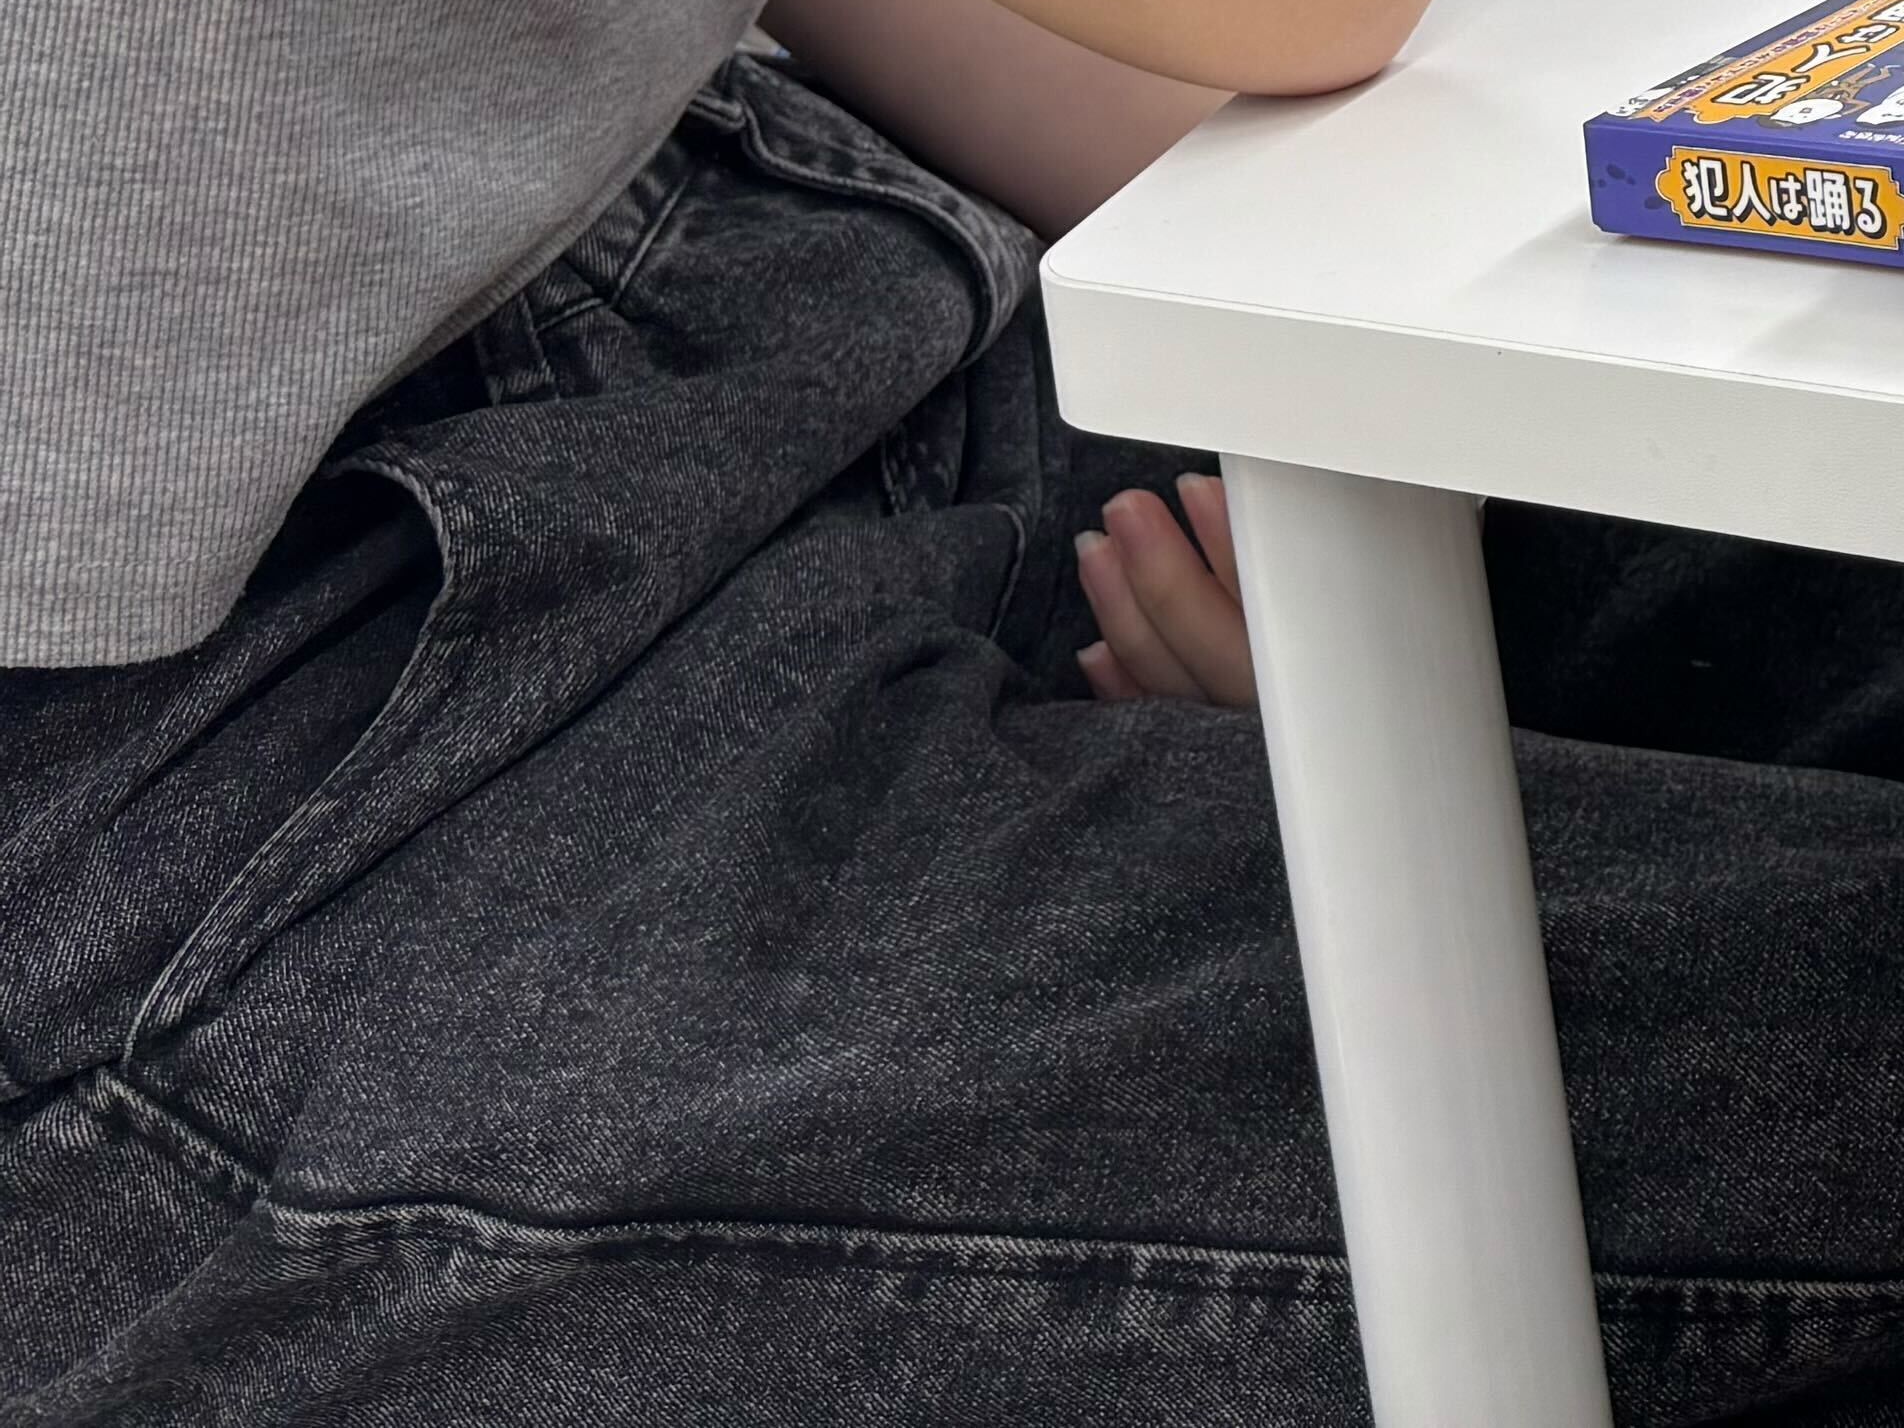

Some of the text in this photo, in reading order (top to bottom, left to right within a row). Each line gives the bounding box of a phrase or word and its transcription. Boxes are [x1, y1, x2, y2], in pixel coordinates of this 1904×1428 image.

[1683, 157, 1887, 236] 犯人は踊る
